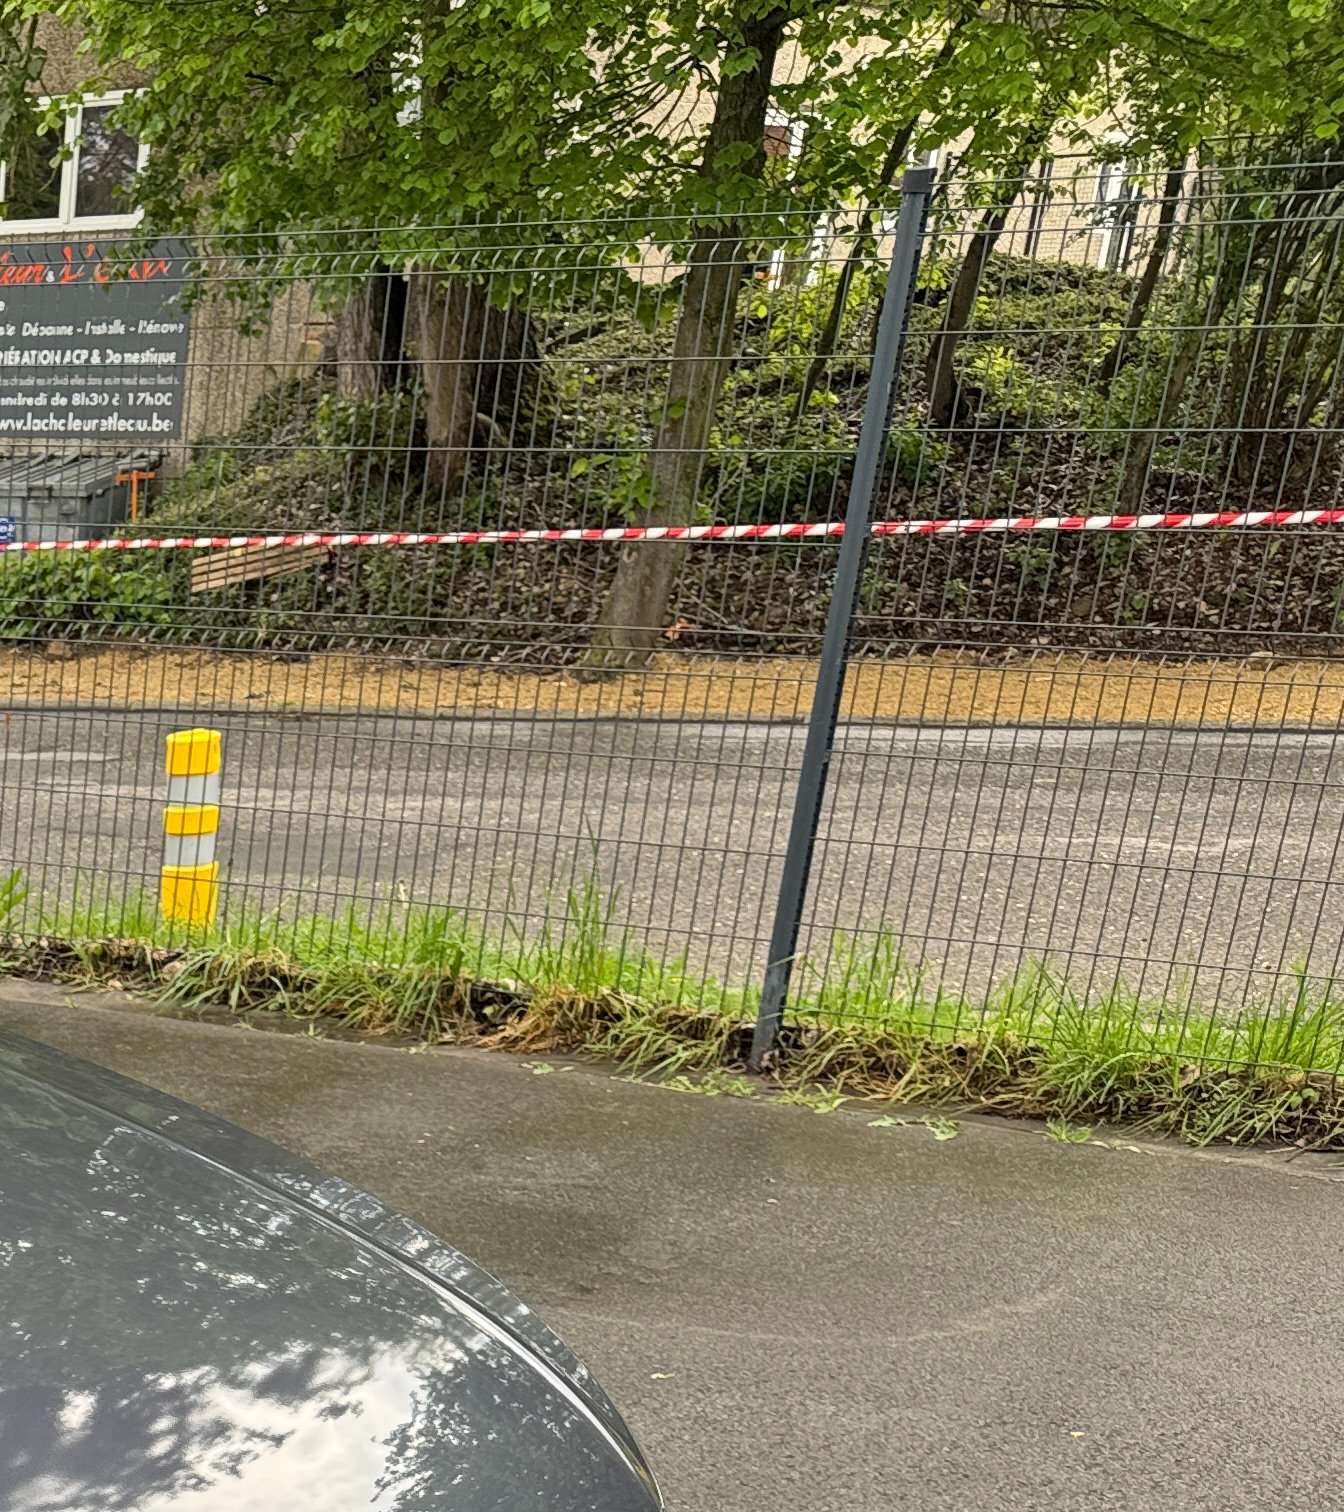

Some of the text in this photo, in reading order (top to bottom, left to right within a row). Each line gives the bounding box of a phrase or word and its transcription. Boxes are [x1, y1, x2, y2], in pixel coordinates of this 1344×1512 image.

[21, 321, 74, 337] Dépanne
[84, 318, 127, 336] Installe
[63, 348, 89, 366] ACP
[90, 349, 102, 365] &
[105, 347, 177, 368] Domestique
[50, 392, 68, 406] de
[71, 392, 109, 407] 8h30
[127, 392, 173, 407] 17h00
